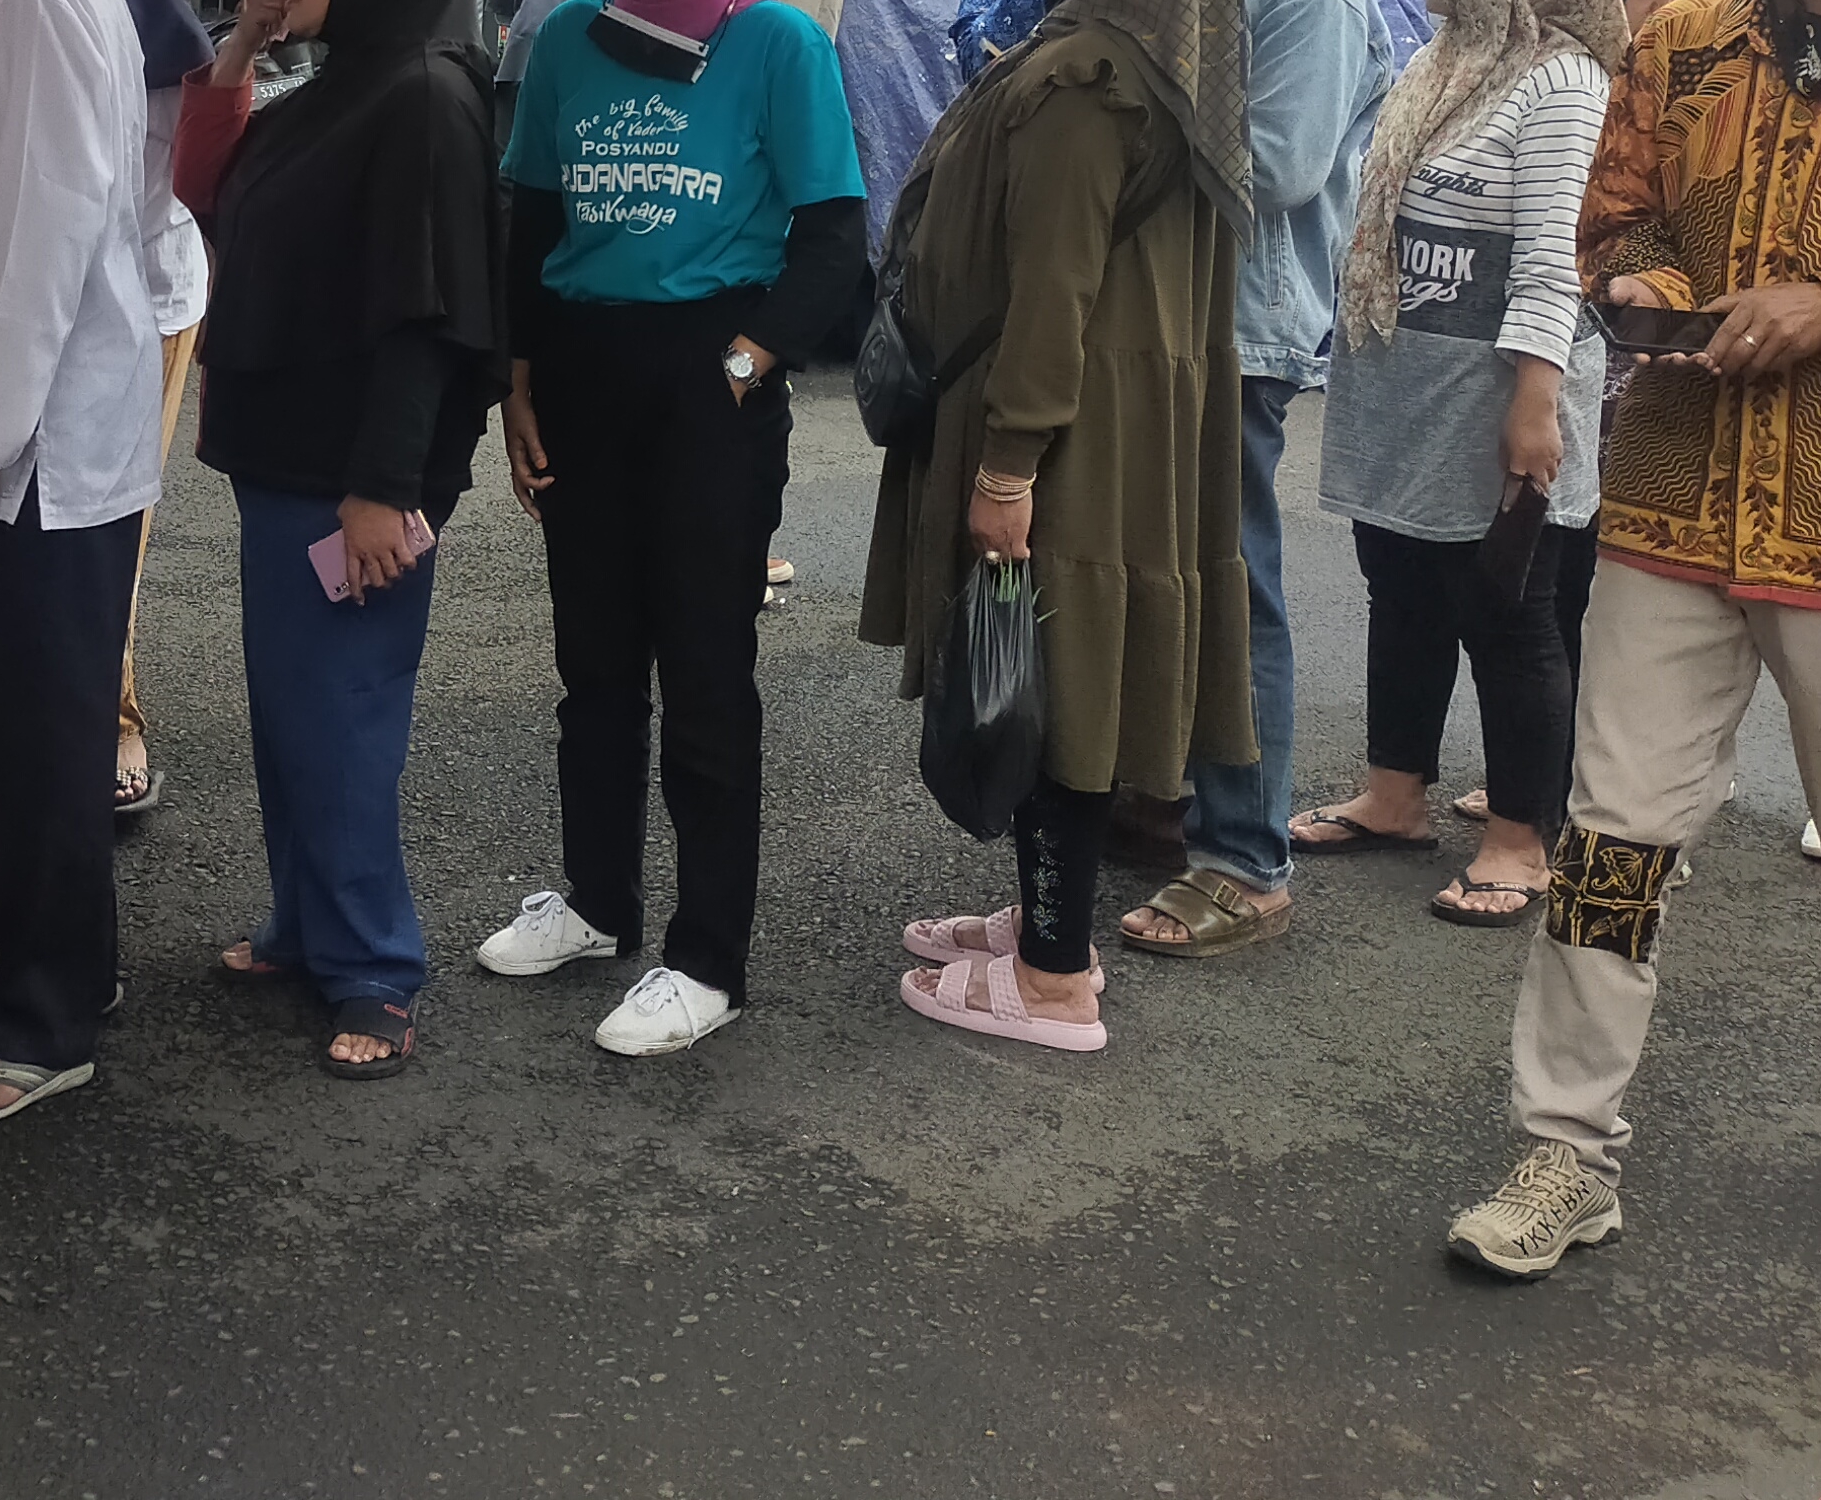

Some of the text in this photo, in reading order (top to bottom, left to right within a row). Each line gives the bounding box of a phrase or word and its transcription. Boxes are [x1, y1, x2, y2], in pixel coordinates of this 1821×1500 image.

[574, 113, 601, 138] the
[609, 98, 642, 120] big
[603, 120, 625, 140] of
[1401, 234, 1476, 282] YORK
